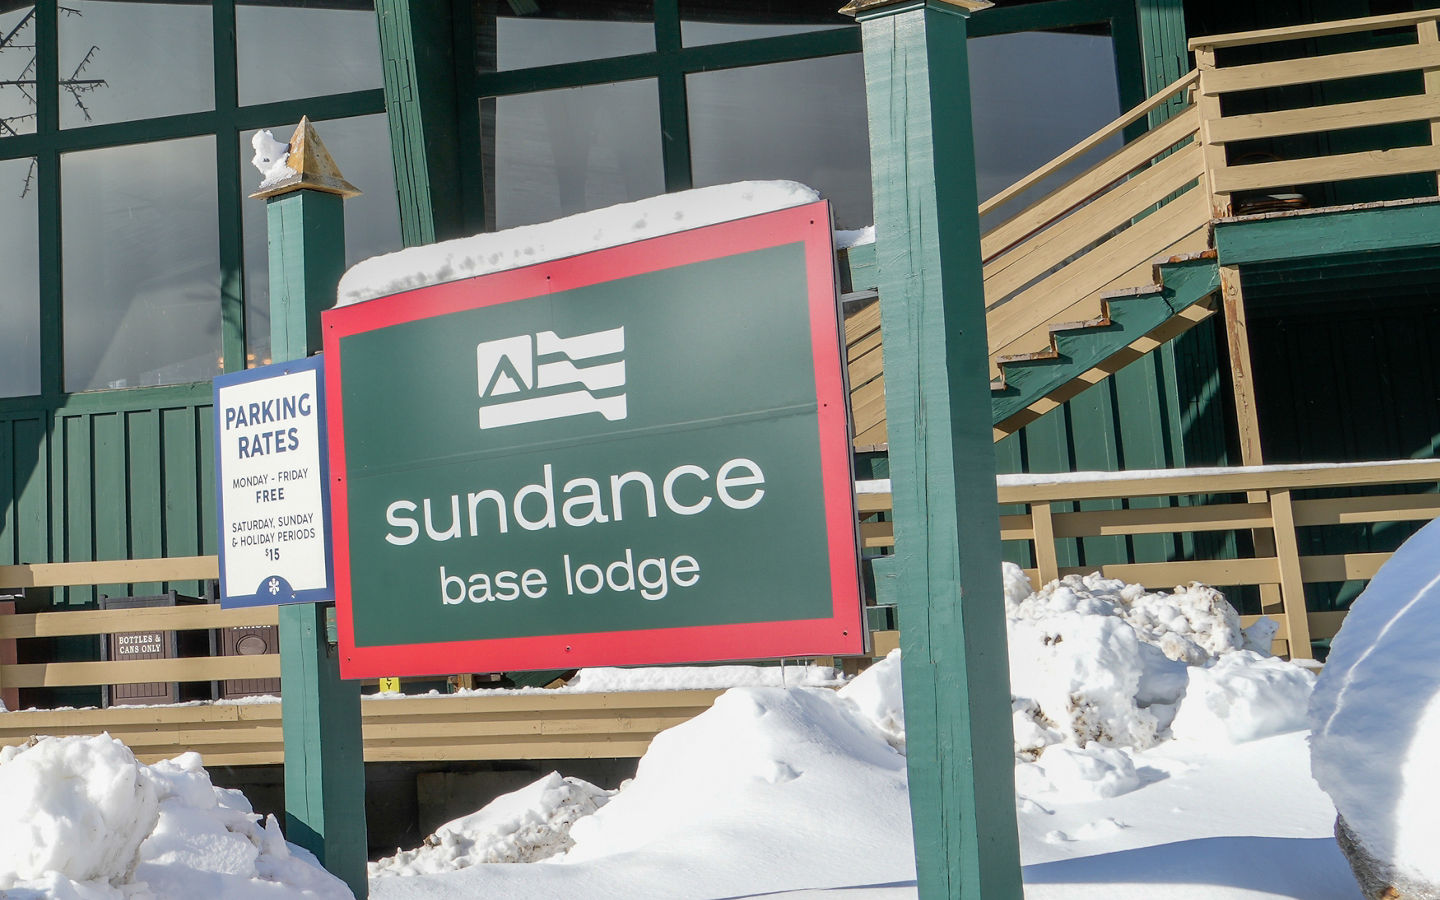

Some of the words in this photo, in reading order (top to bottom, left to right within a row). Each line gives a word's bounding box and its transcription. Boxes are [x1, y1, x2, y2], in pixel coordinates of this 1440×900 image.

[225, 392, 311, 430] PARKING
[238, 427, 299, 459] RATES
[232, 474, 269, 489] MONDAY
[278, 468, 309, 483] FRIDAY
[256, 487, 285, 503] FREE
[385, 458, 765, 546] sundance
[232, 518, 276, 533] SATURDAY,
[278, 513, 314, 527] SUNDAY
[232, 537, 238, 548] &
[240, 531, 275, 546] HOLIDAY
[277, 528, 316, 542] PERIODS
[265, 548, 280, 561] $15
[440, 566, 548, 605] base
[564, 548, 701, 601] lodge
[119, 634, 153, 645] BOTTLES
[155, 634, 161, 643] &
[119, 646, 139, 654] CANS
[141, 644, 161, 653] ONLY
